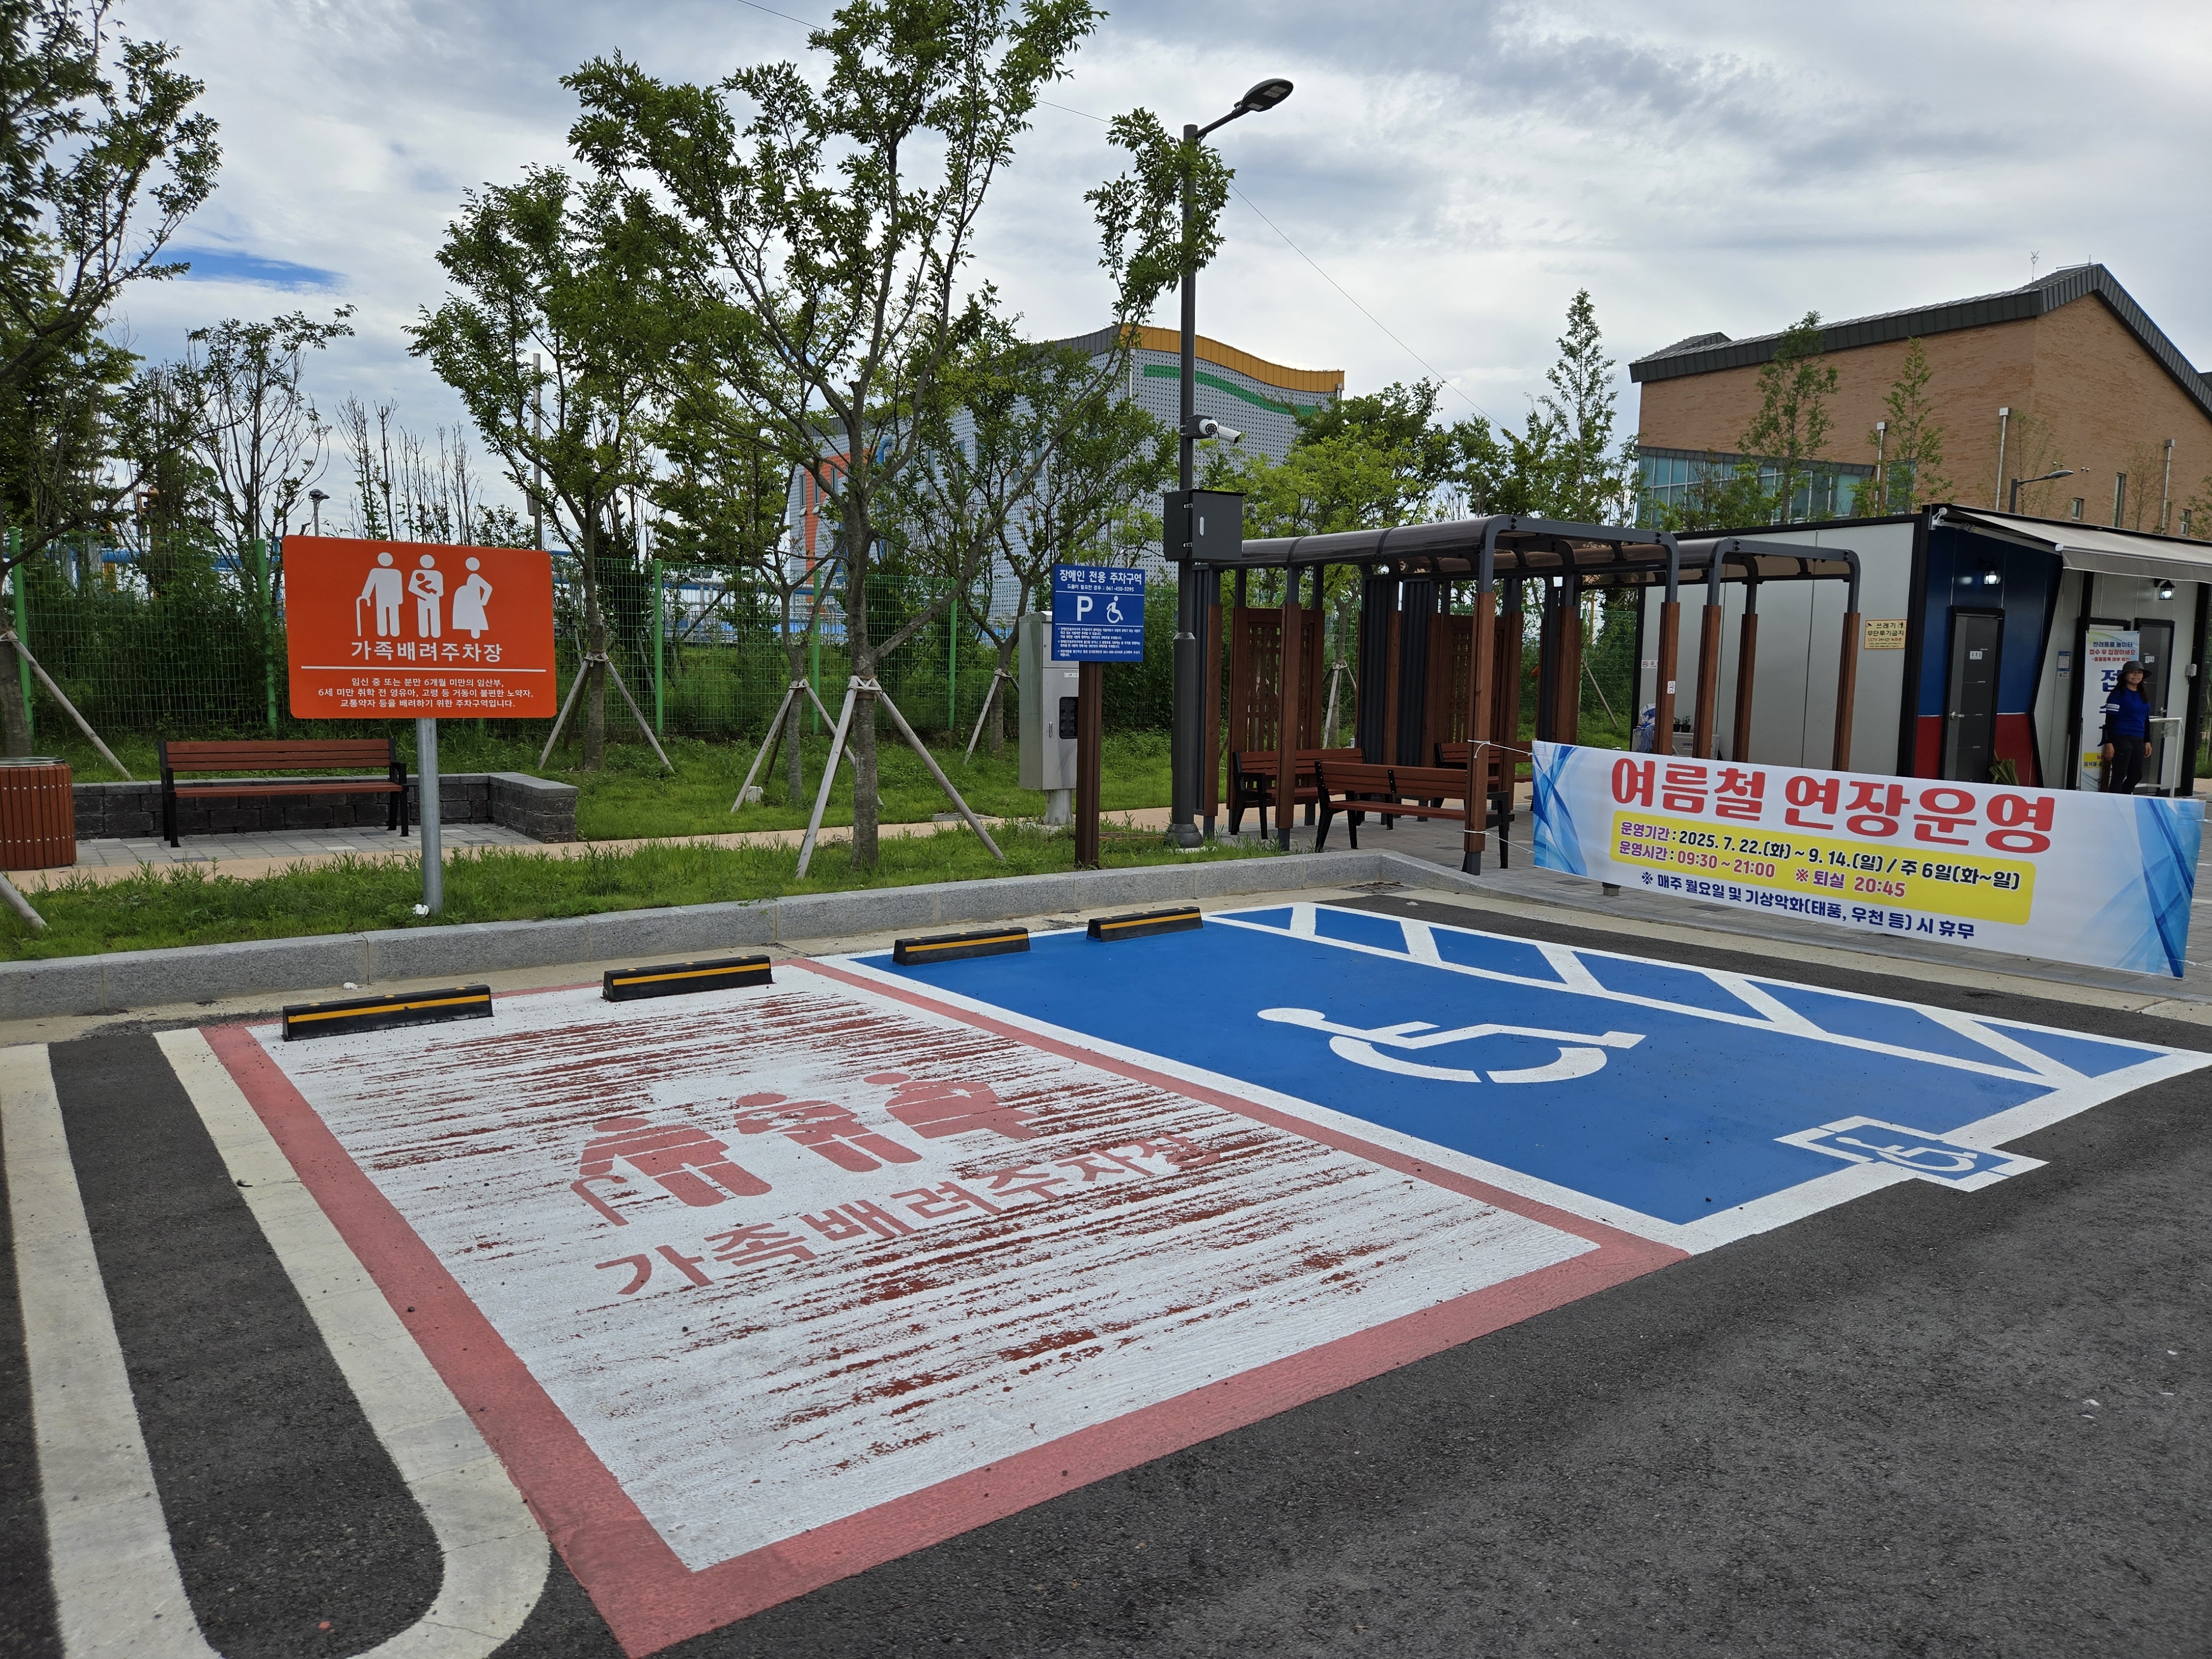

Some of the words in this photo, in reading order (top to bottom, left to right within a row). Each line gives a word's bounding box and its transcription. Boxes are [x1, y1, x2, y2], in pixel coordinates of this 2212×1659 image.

[1060, 570, 1085, 582] 장애인
[1089, 571, 1106, 583] 전용
[1109, 572, 1142, 585] 주차구역
[1077, 596, 1093, 622] P
[351, 640, 503, 662] 가족배려주차장
[318, 688, 333, 696] 6세
[337, 688, 354, 697] 미만
[357, 688, 375, 697] 취학
[378, 688, 387, 697] 전
[390, 688, 419, 697] 영유아,
[441, 689, 450, 697] 등
[453, 689, 477, 697] 거동이
[480, 689, 504, 697] 불편한
[352, 677, 369, 686] 임신
[372, 678, 381, 686] 중
[404, 678, 421, 686] 분만
[424, 678, 446, 686] 6개월
[450, 679, 474, 687] 미만의
[477, 679, 504, 687] 임산부,
[340, 699, 376, 707] 교통약자
[379, 699, 396, 708] 등을
[399, 699, 433, 707] 배려하기
[436, 699, 453, 707] 위한
[1611, 758, 1766, 821] 여름철
[1785, 775, 2055, 854] 연장운영
[1621, 821, 1670, 842] 운영기간
[1679, 830, 1719, 849] 2025.
[1723, 837, 1735, 851] 7.
[1739, 839, 1791, 859] 22.(화)
[1809, 848, 1823, 864] 9.
[1828, 851, 1882, 872] 14.(일)
[1900, 859, 1918, 876] 주
[1922, 863, 2020, 890] 6일(화~일)
[1619, 841, 1668, 861] 운영시간
[1677, 850, 1718, 869] 09:30
[1734, 859, 1775, 878] 21:00
[1813, 869, 1845, 889] 퇴실
[1854, 876, 1906, 898] 20:45
[1657, 874, 1682, 890] 매주
[1686, 879, 1724, 899] 월요일
[1728, 886, 1741, 902] 및
[1746, 889, 1846, 921] 기상악화(태풍,
[1851, 906, 1884, 926] 우천
[1888, 910, 1912, 930] 등)
[1917, 917, 1933, 933] 시
[1939, 920, 1975, 940] 휴무
[594, 1133, 1220, 1295] 가족배려주차장
